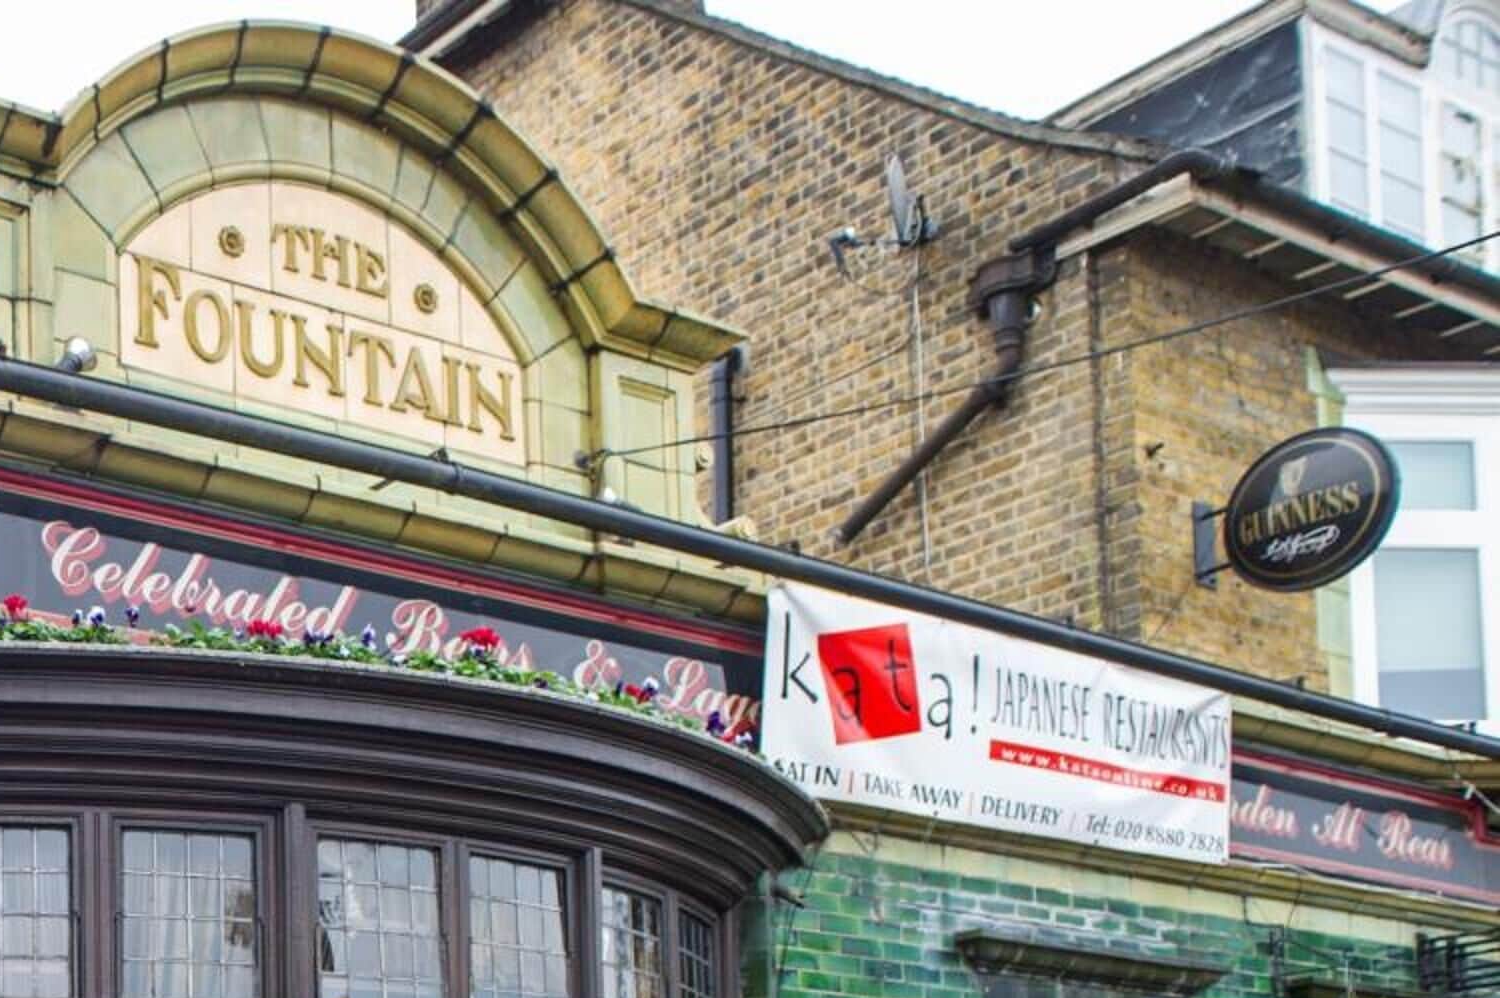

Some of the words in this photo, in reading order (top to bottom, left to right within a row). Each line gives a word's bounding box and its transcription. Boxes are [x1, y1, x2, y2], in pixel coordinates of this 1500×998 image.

[271, 223, 389, 298] THE
[133, 255, 516, 441] FOUNTAIN
[1238, 482, 1360, 546] GUINNESS
[41, 520, 355, 638] Celebrated
[990, 667, 1091, 742] JAPANESE
[1103, 691, 1230, 770] RESTAURANTS
[814, 764, 841, 788] IN
[863, 772, 904, 800] TAKE
[910, 783, 965, 811] AWAY
[981, 794, 1062, 828] DELIVERY
